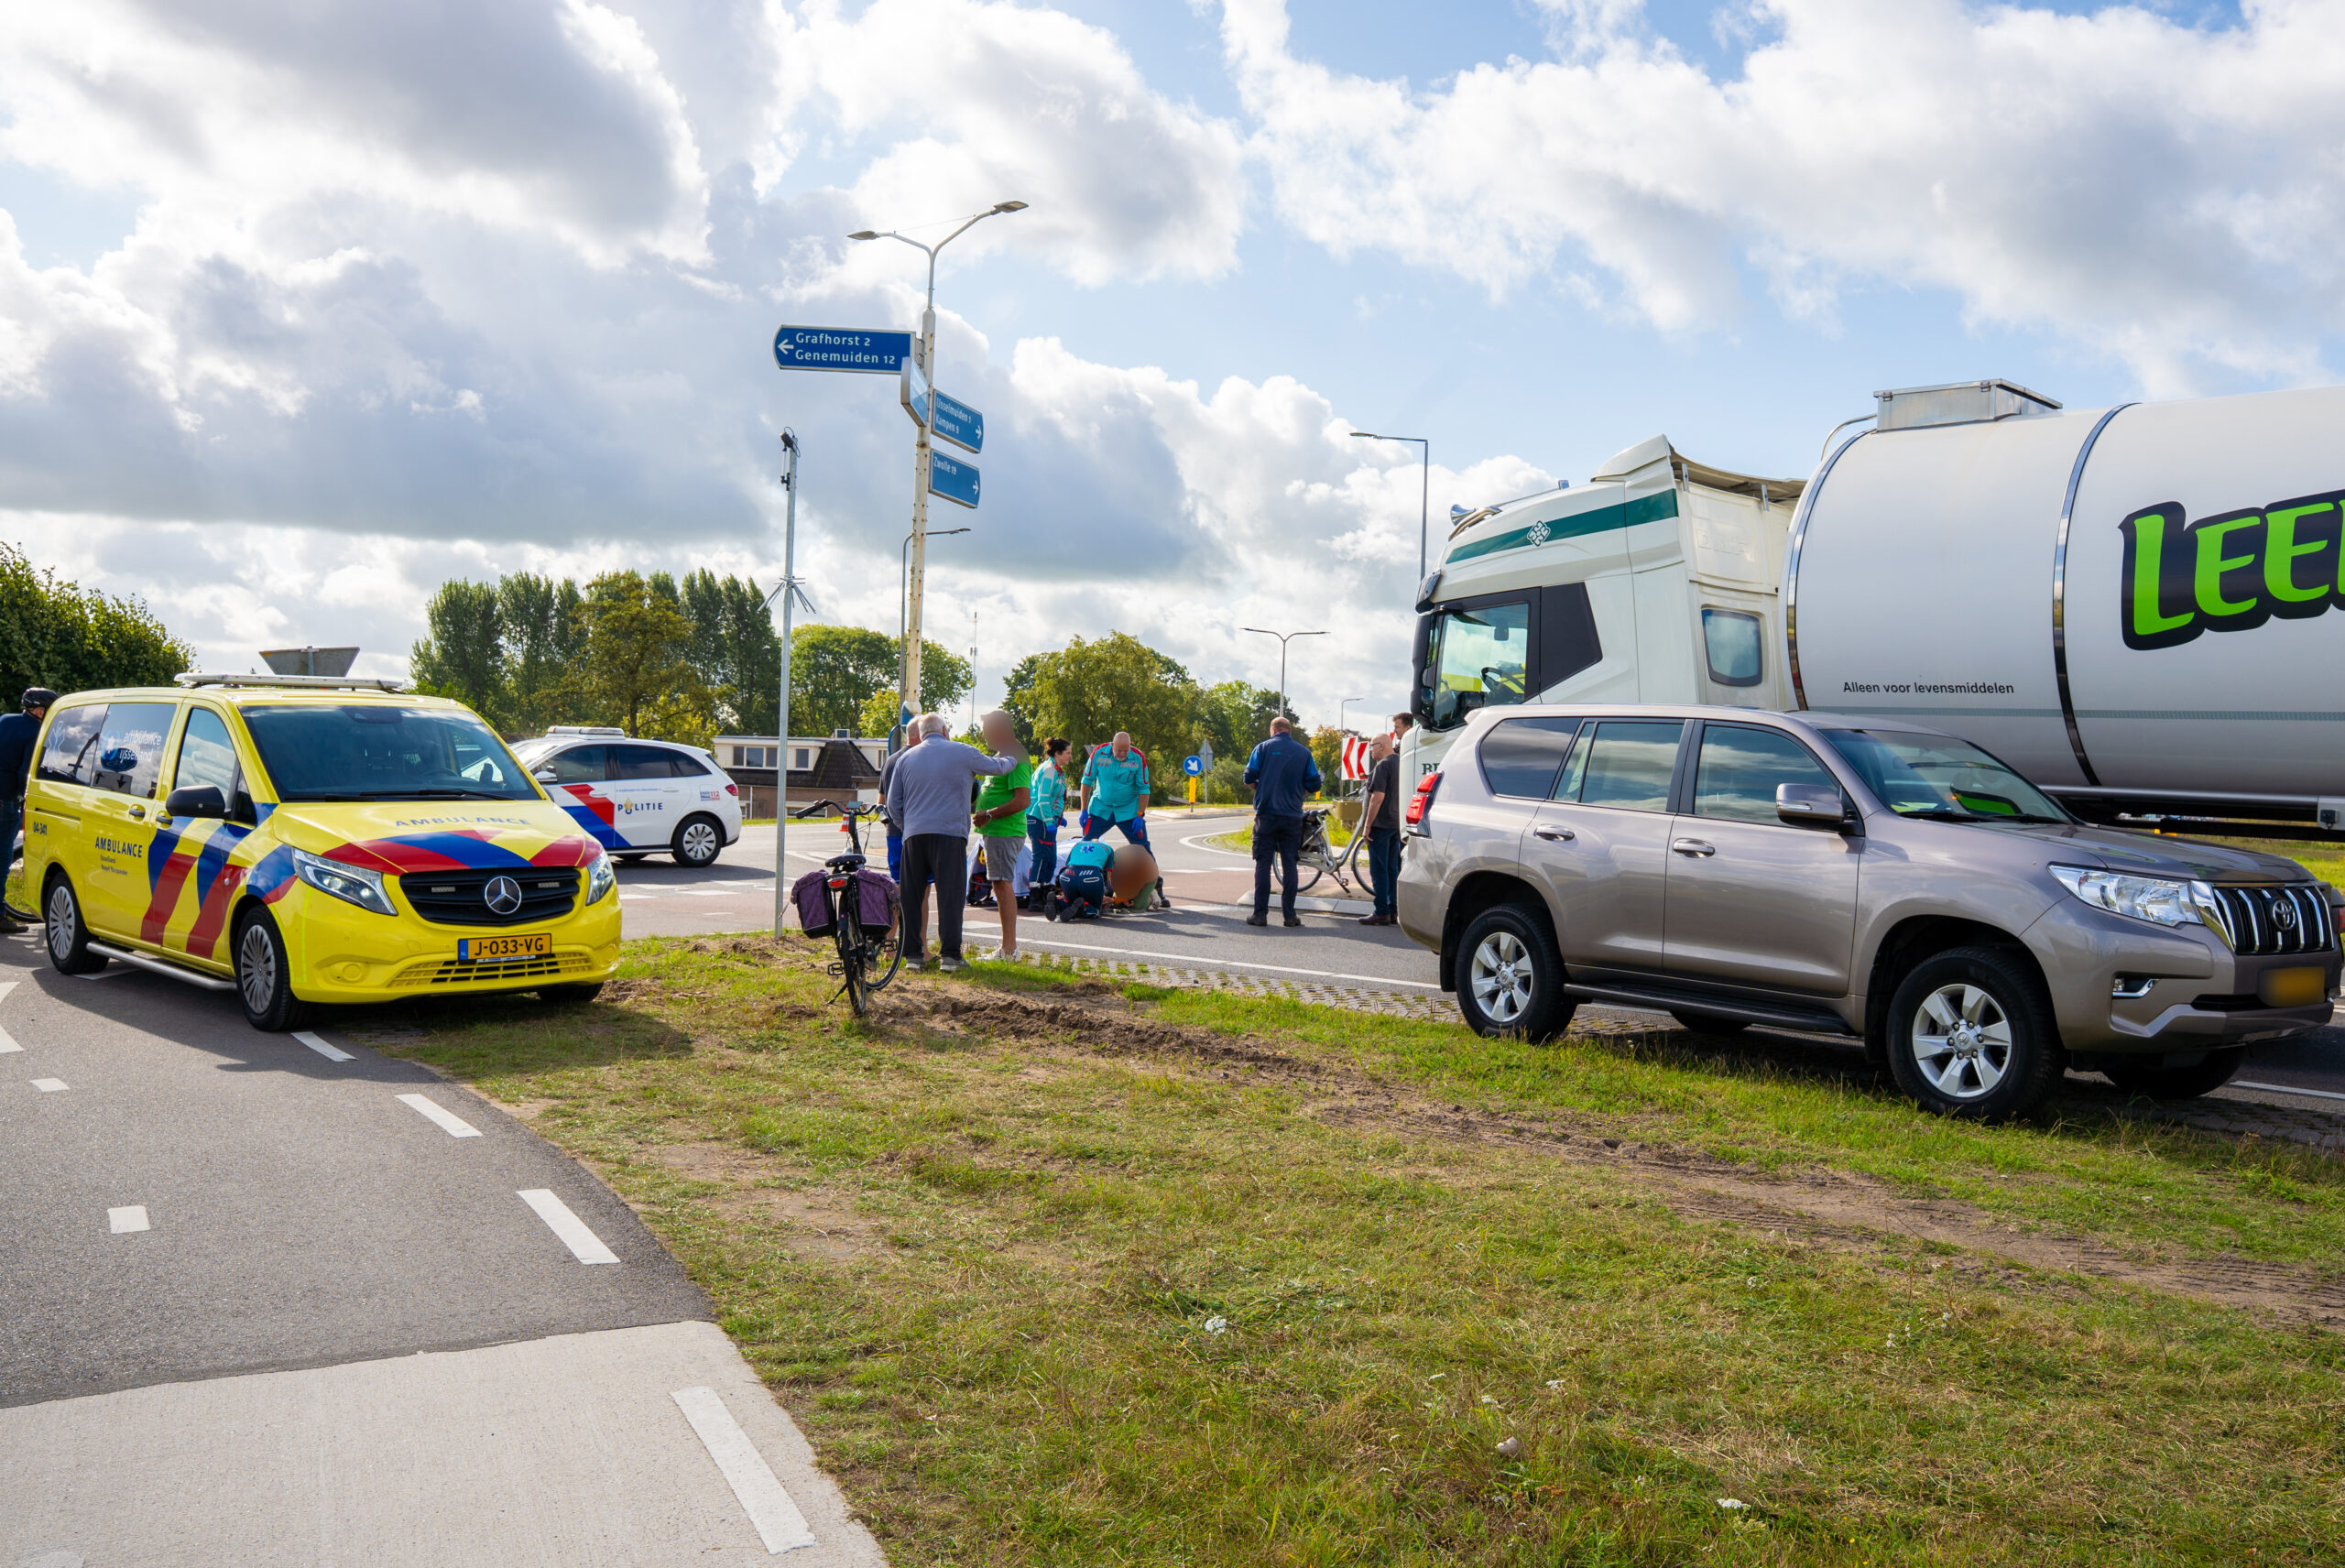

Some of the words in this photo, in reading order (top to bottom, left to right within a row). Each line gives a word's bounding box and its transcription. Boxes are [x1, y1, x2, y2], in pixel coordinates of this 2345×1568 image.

[795, 332, 860, 346] Grafhorst
[864, 337, 871, 346] 2
[795, 349, 878, 364] Genemuiden
[883, 355, 896, 365] 12
[935, 414, 956, 431] Kampen
[933, 456, 951, 473] Zwolle
[2130, 497, 2345, 639] LEE
[1843, 681, 1881, 693] Alleen
[1883, 684, 1911, 693] voor
[1914, 681, 2015, 694] levensmiddelen
[123, 729, 162, 746] ambulance
[617, 802, 663, 815] POLITIE
[395, 817, 532, 827] AMBULANCE
[95, 836, 143, 858] AMBULANCE
[474, 937, 543, 956] J-033-VG
